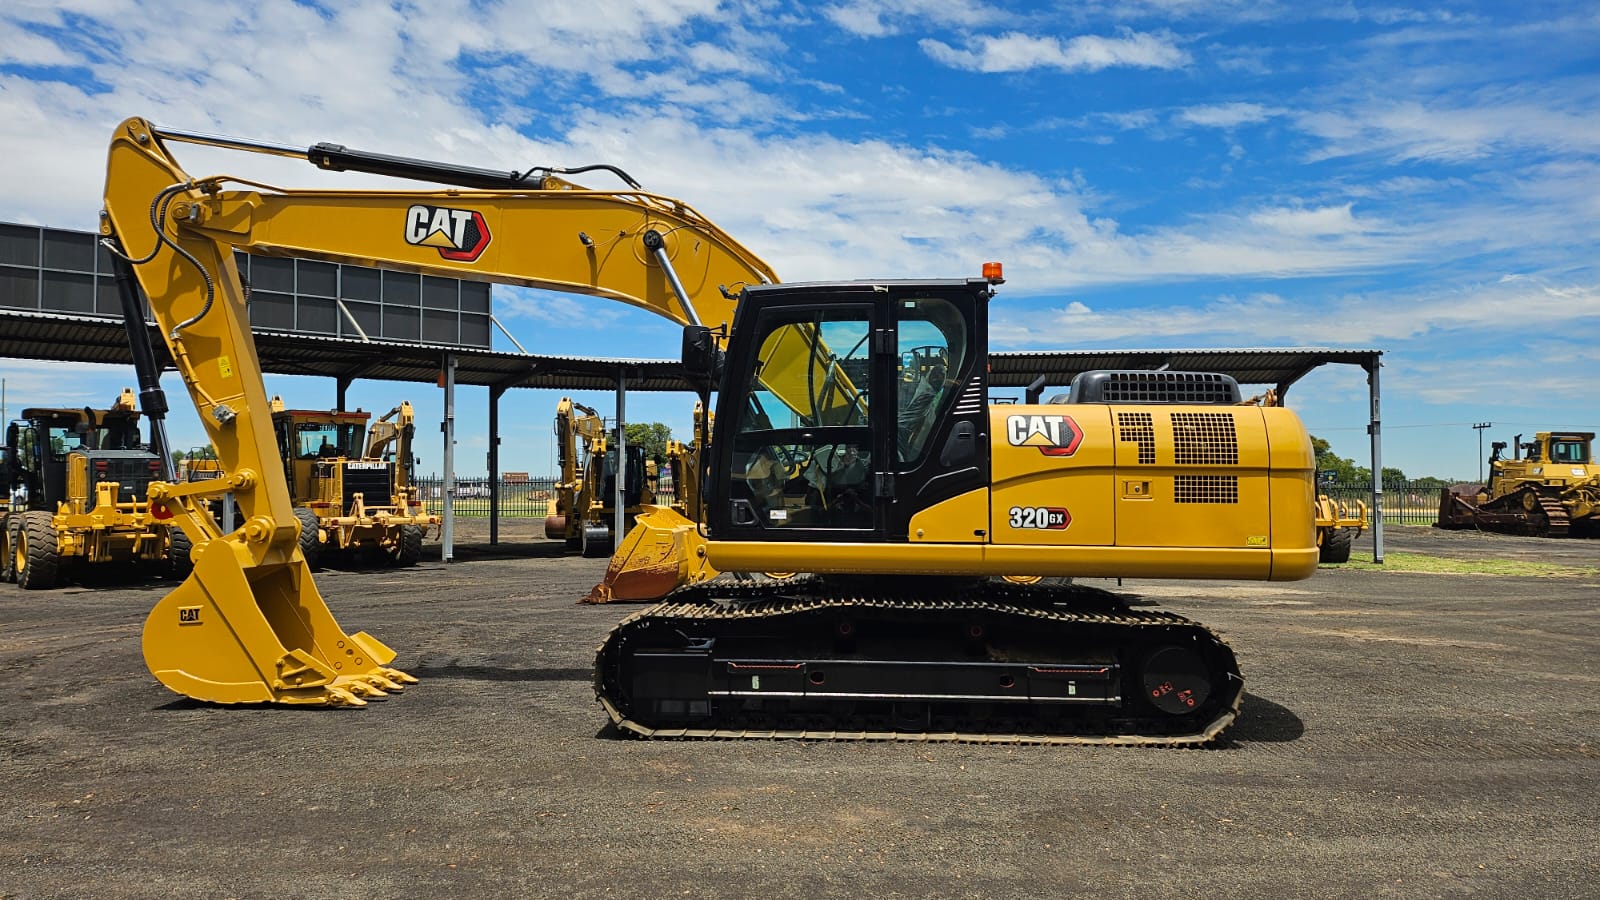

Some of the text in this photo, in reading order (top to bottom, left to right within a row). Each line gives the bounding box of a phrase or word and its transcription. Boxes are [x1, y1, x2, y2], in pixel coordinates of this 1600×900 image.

[405, 205, 472, 249] CAT
[1007, 415, 1063, 446] CAT
[347, 462, 387, 470] CATERPILLAR
[180, 608, 200, 621] CAT
